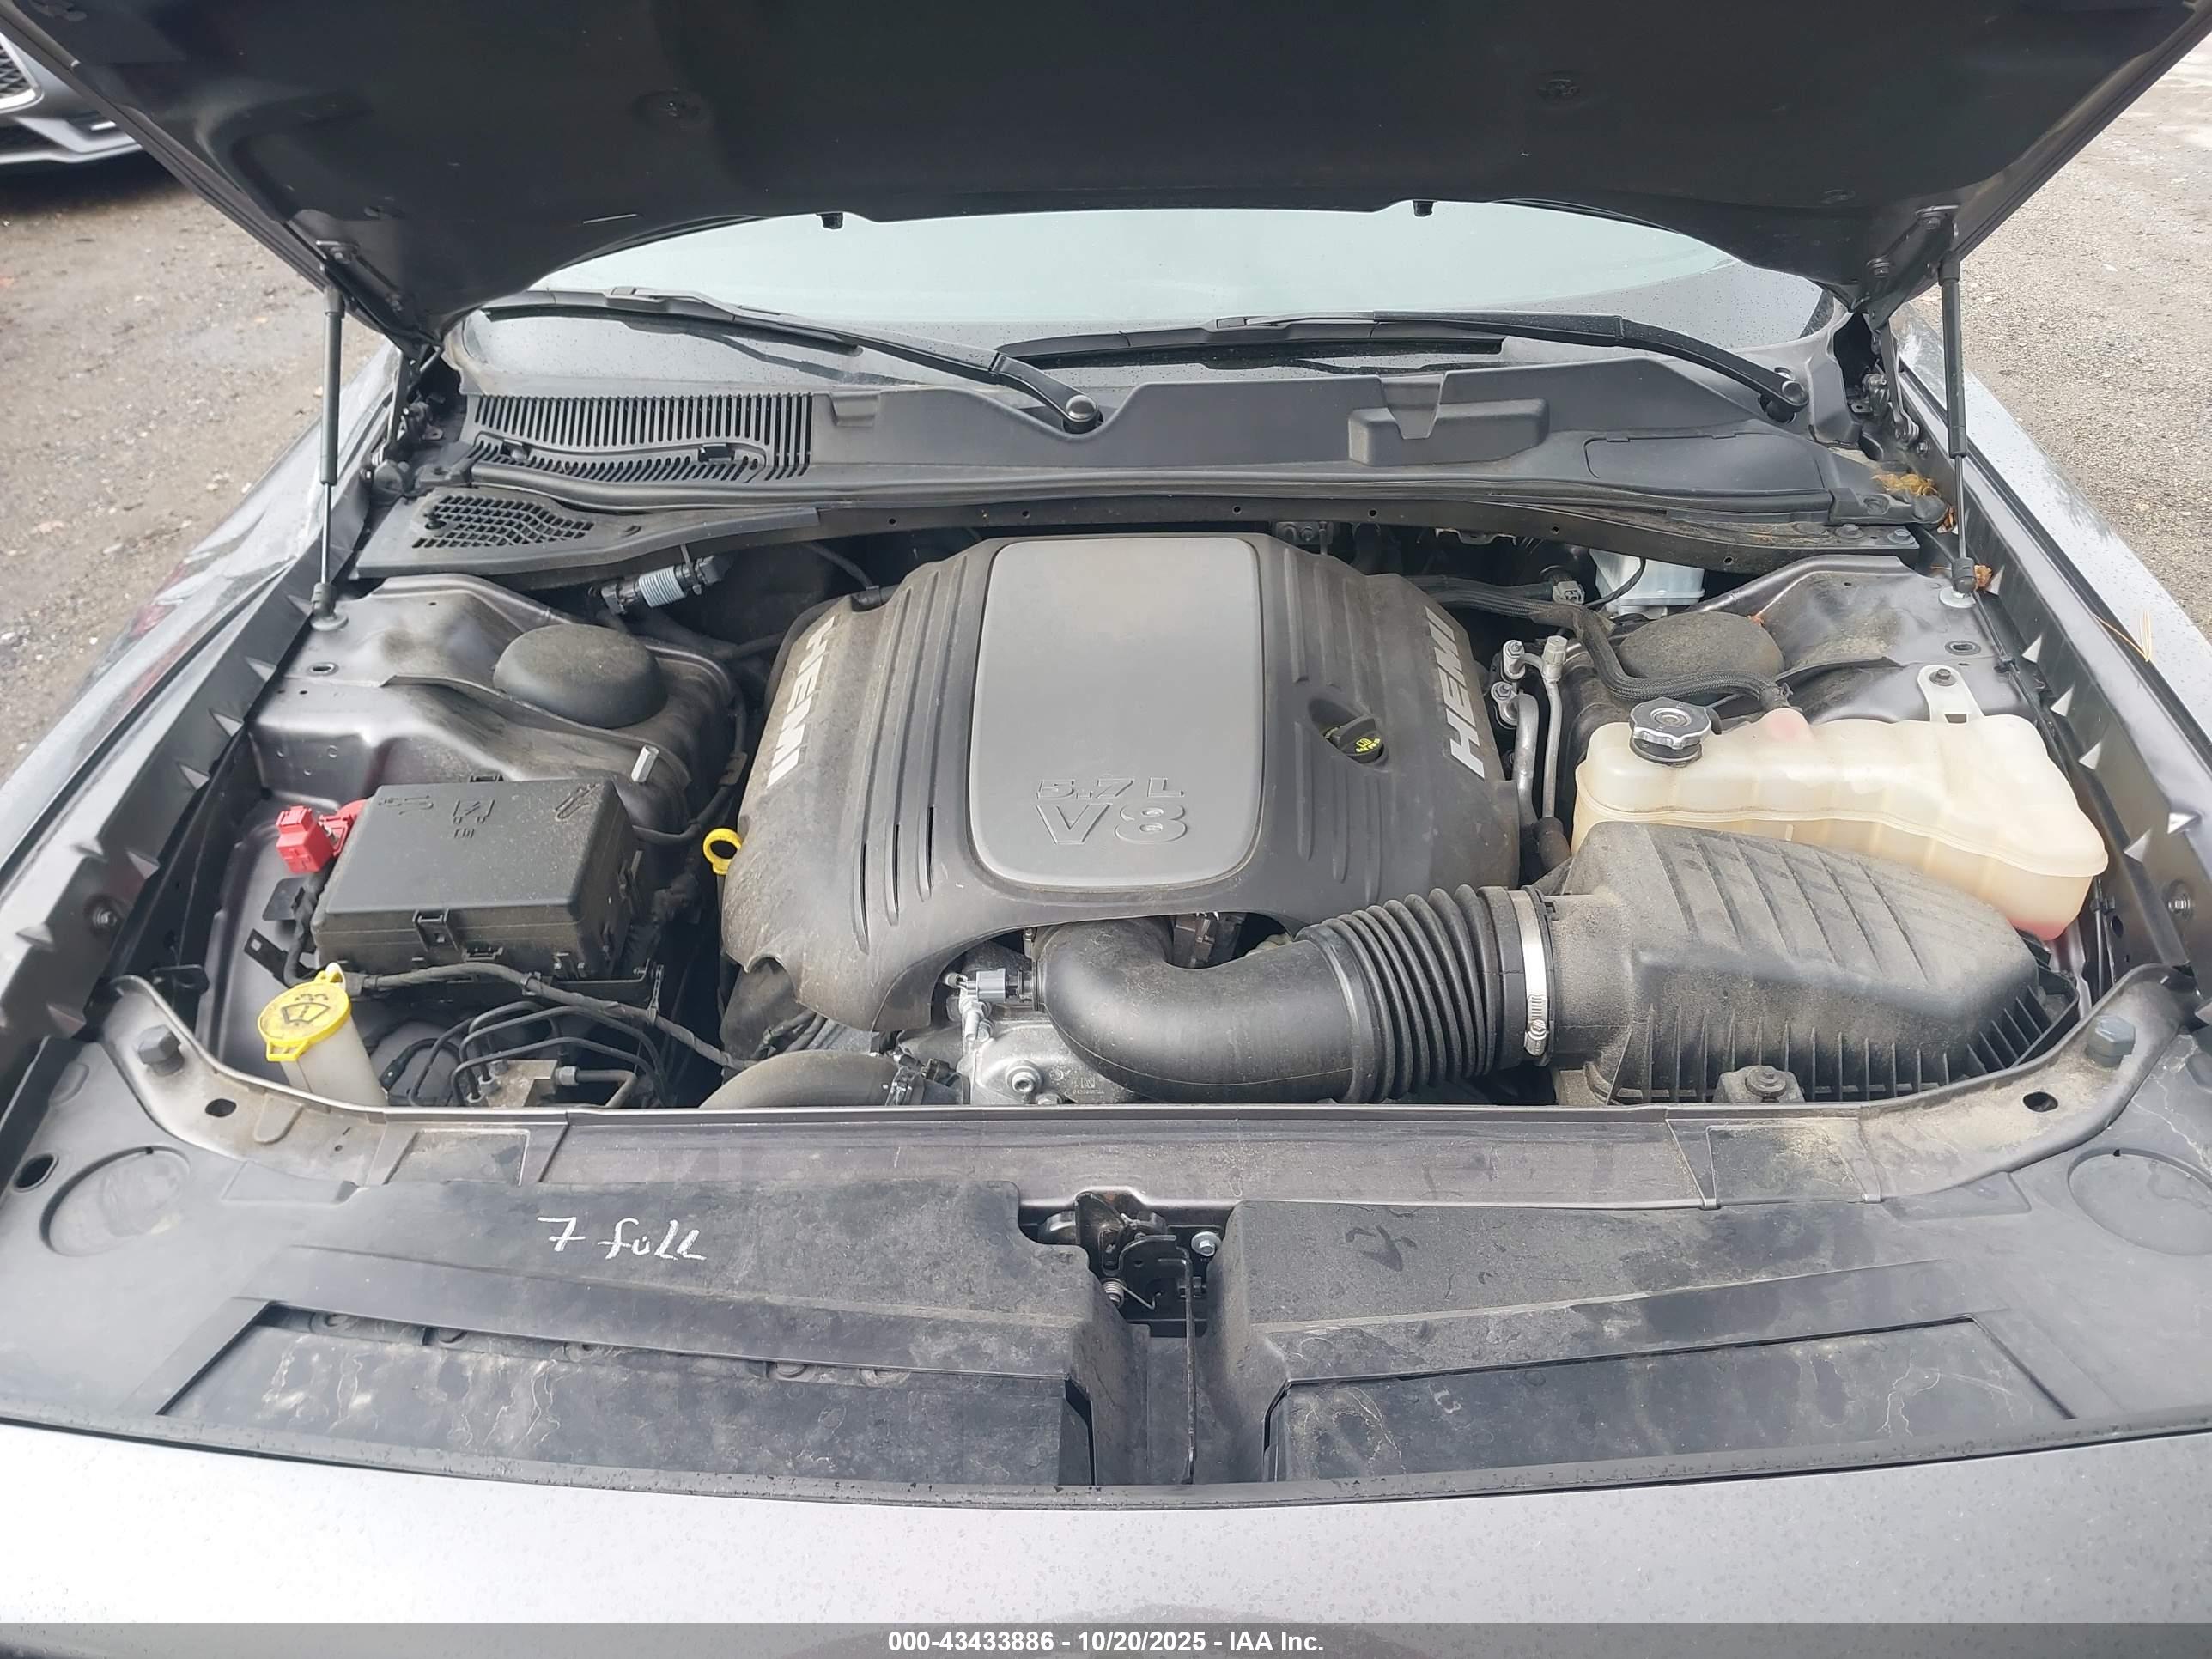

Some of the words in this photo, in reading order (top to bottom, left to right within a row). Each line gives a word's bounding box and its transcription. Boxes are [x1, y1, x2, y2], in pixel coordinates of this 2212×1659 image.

[767, 616, 836, 788] HEMI
[1425, 605, 1486, 780] HEMI
[1035, 803, 1188, 845] V8
[538, 1216, 586, 1251] 7
